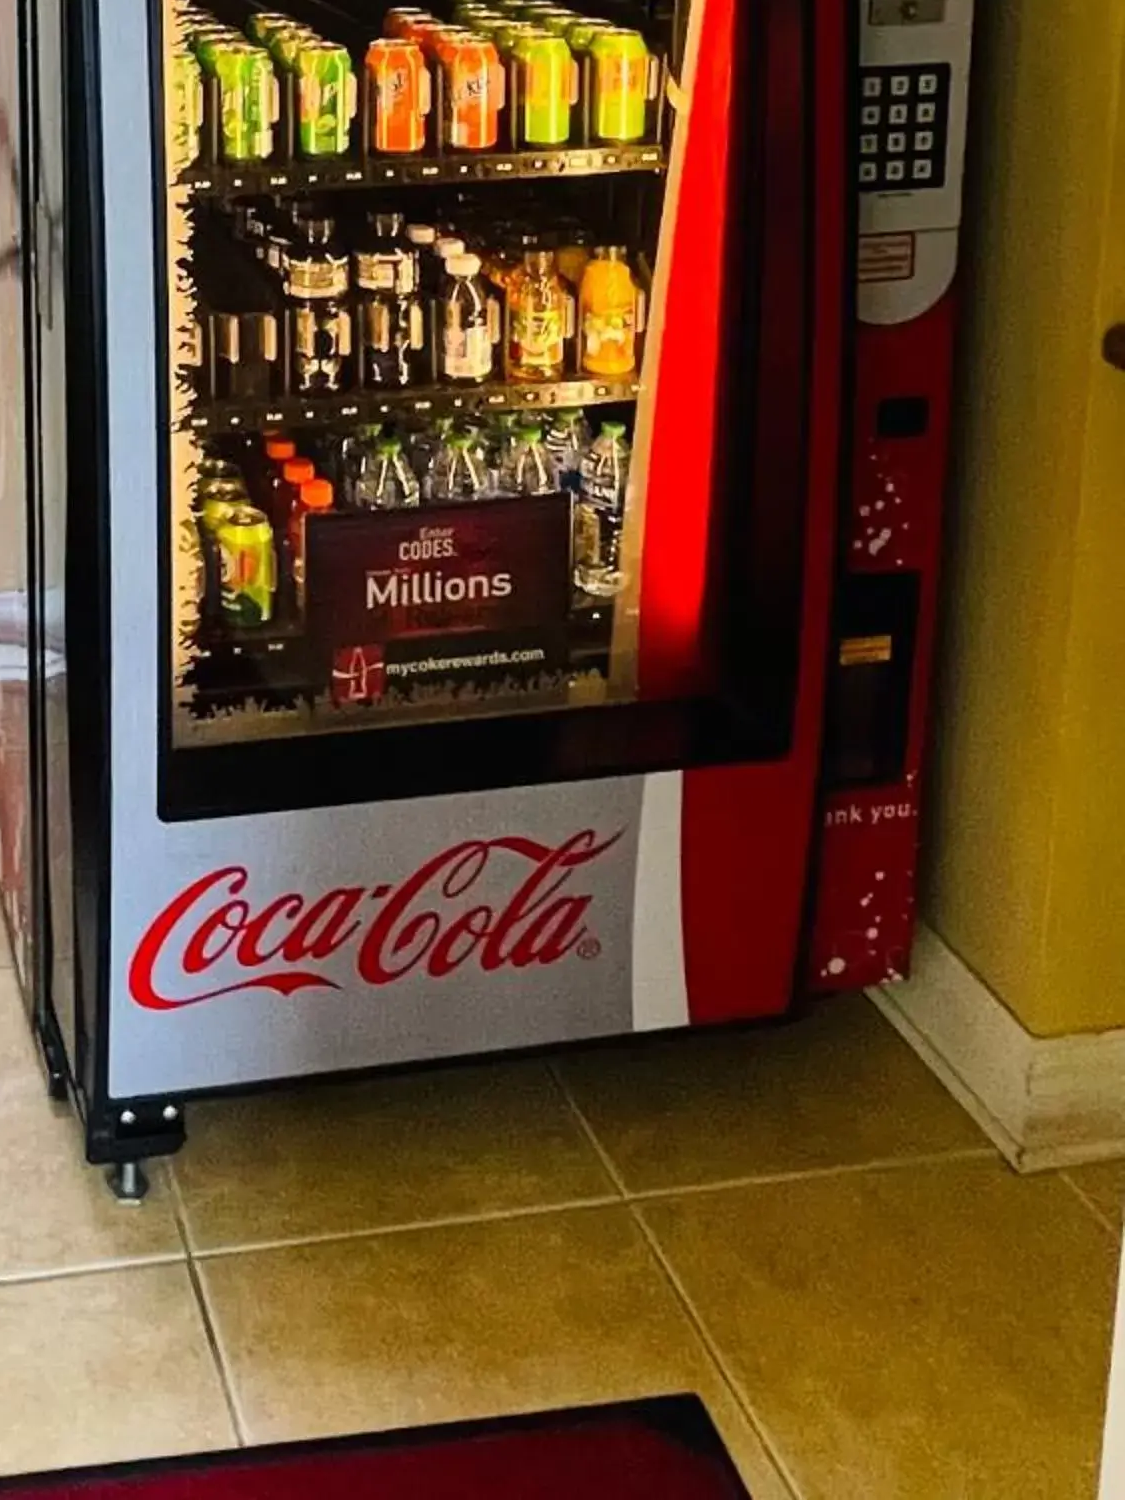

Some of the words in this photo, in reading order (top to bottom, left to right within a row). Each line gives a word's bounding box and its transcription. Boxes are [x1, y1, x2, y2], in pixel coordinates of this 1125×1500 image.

[366, 571, 512, 610] Millions
[385, 647, 545, 677] mycokerewards.com
[127, 827, 628, 1012] Coca-Cola
